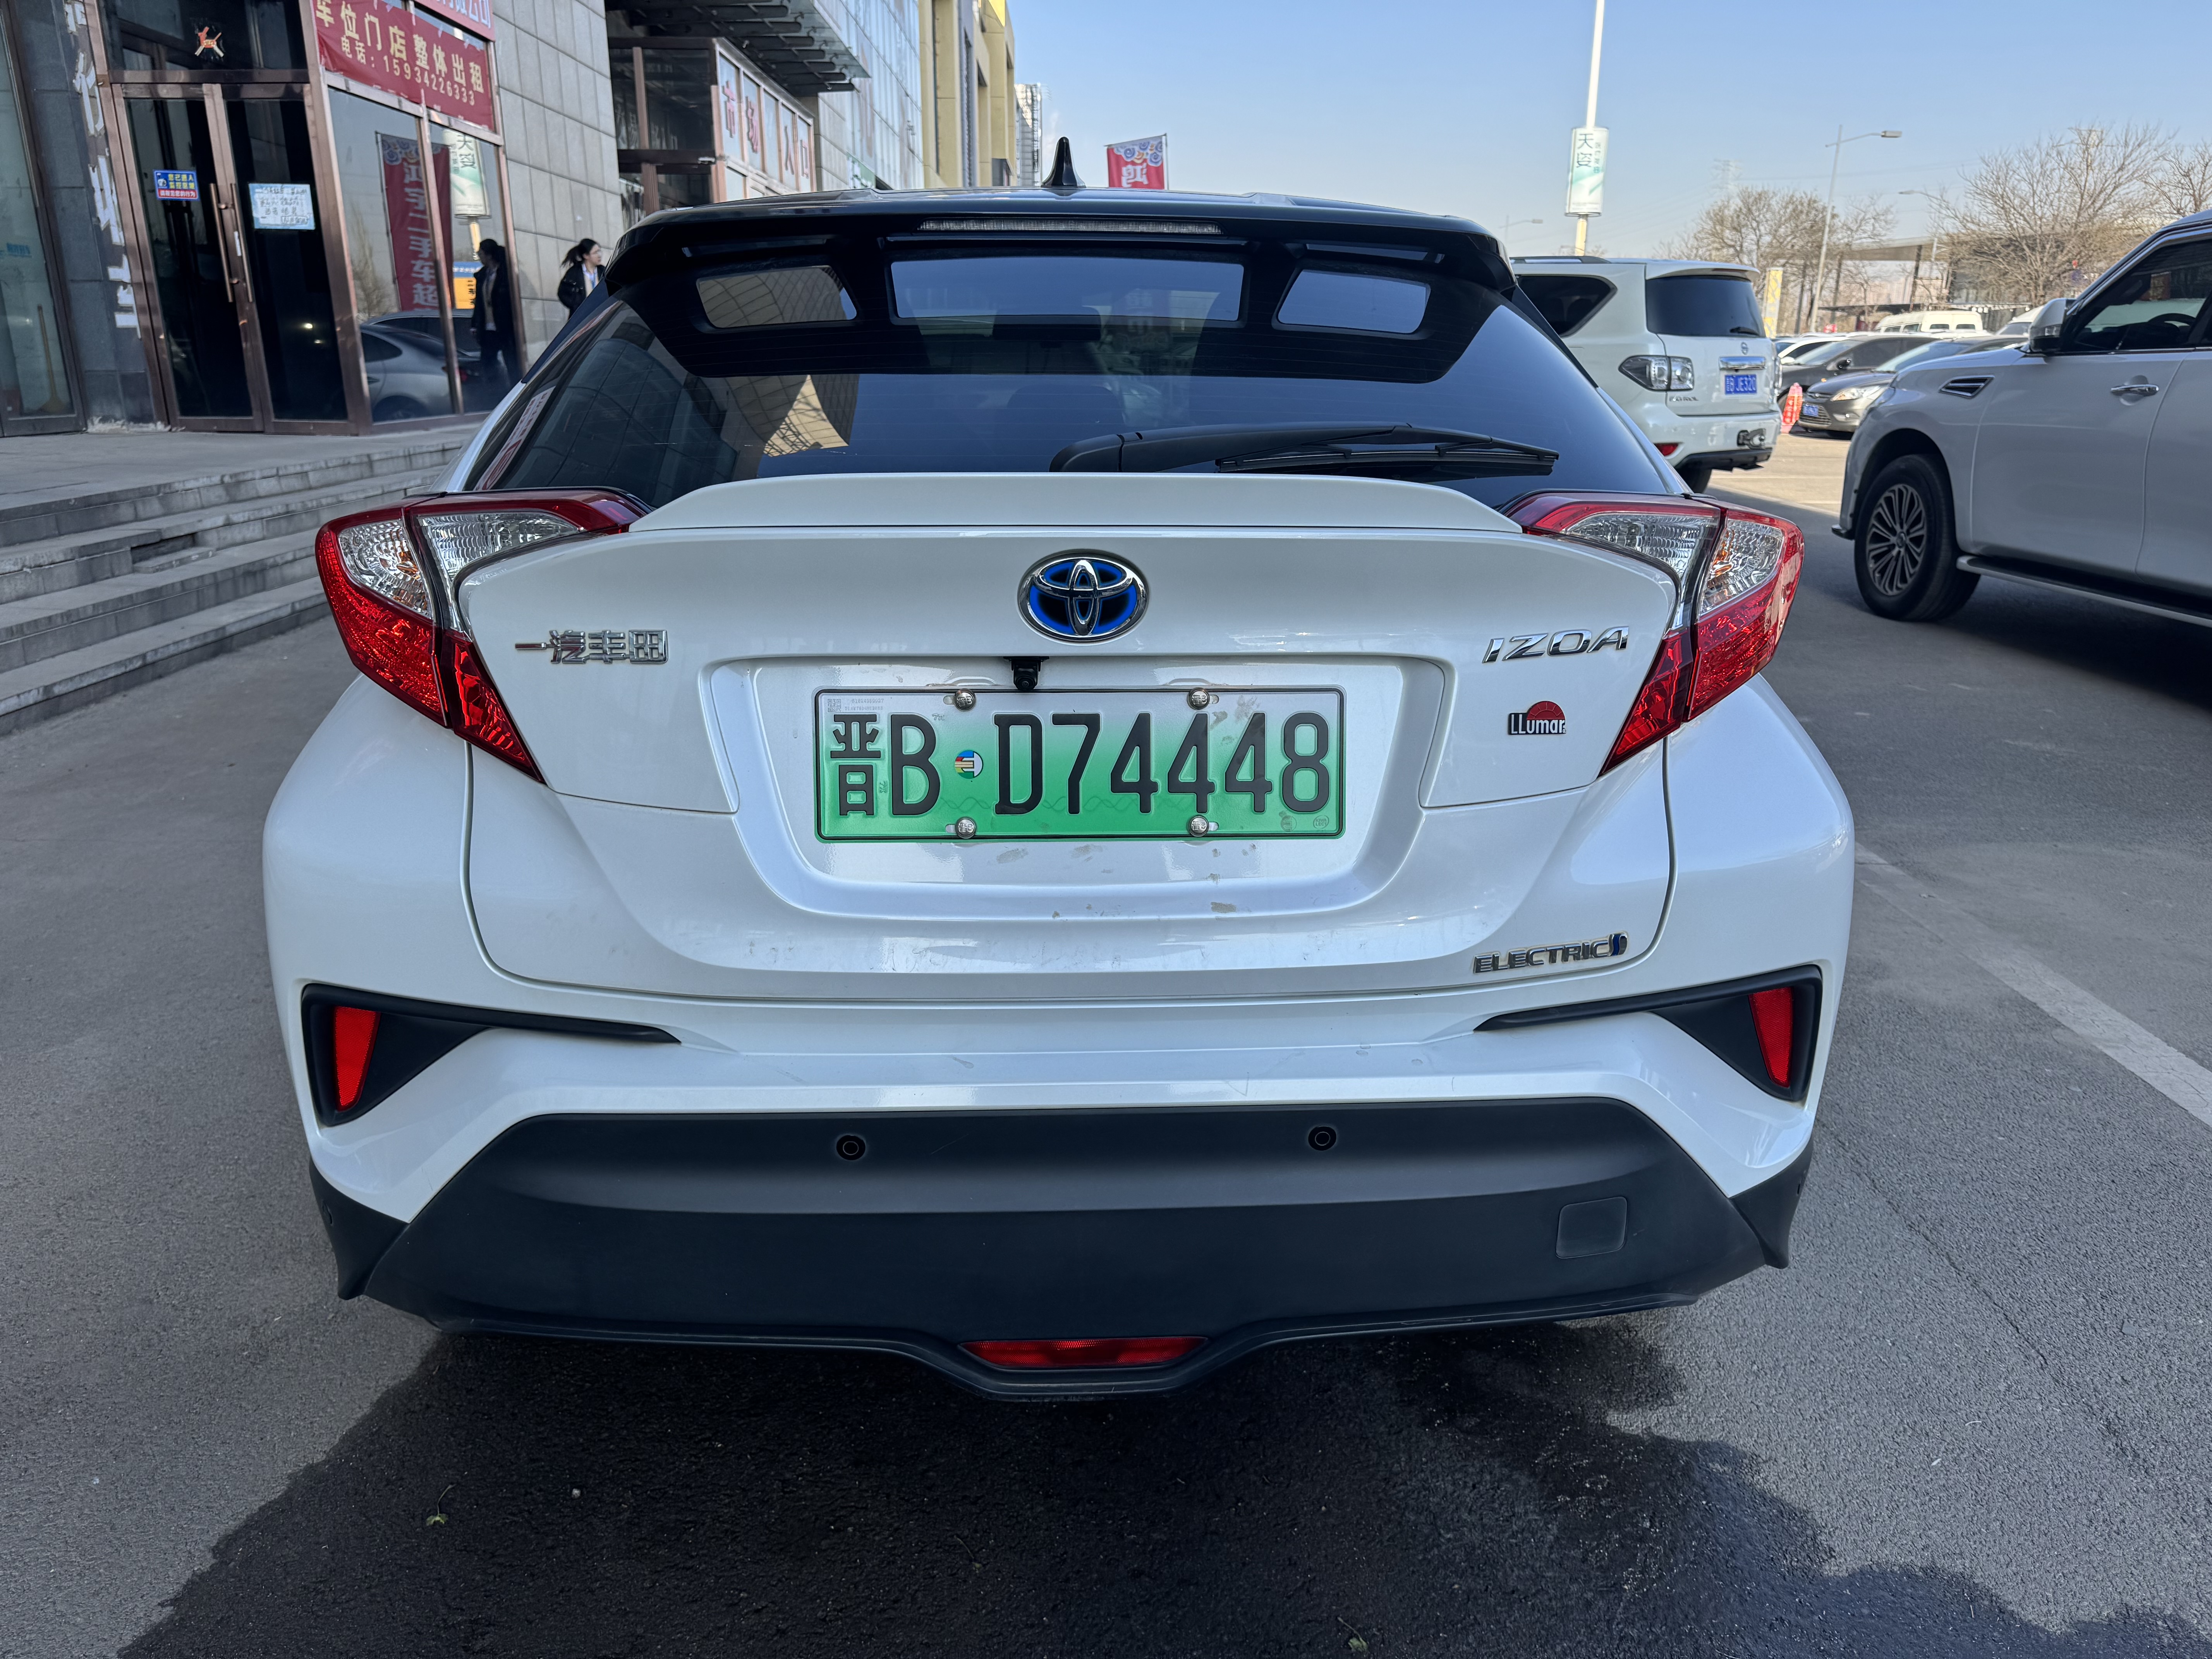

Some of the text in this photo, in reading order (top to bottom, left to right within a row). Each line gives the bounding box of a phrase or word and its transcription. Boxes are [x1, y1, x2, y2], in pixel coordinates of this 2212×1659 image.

[515, 630, 668, 665] 一汽丰田
[1482, 626, 1629, 664] IZOA
[1511, 714, 1565, 734] LLumar
[994, 712, 1329, 815] D74448
[1473, 939, 1609, 974] ELECTRIC
